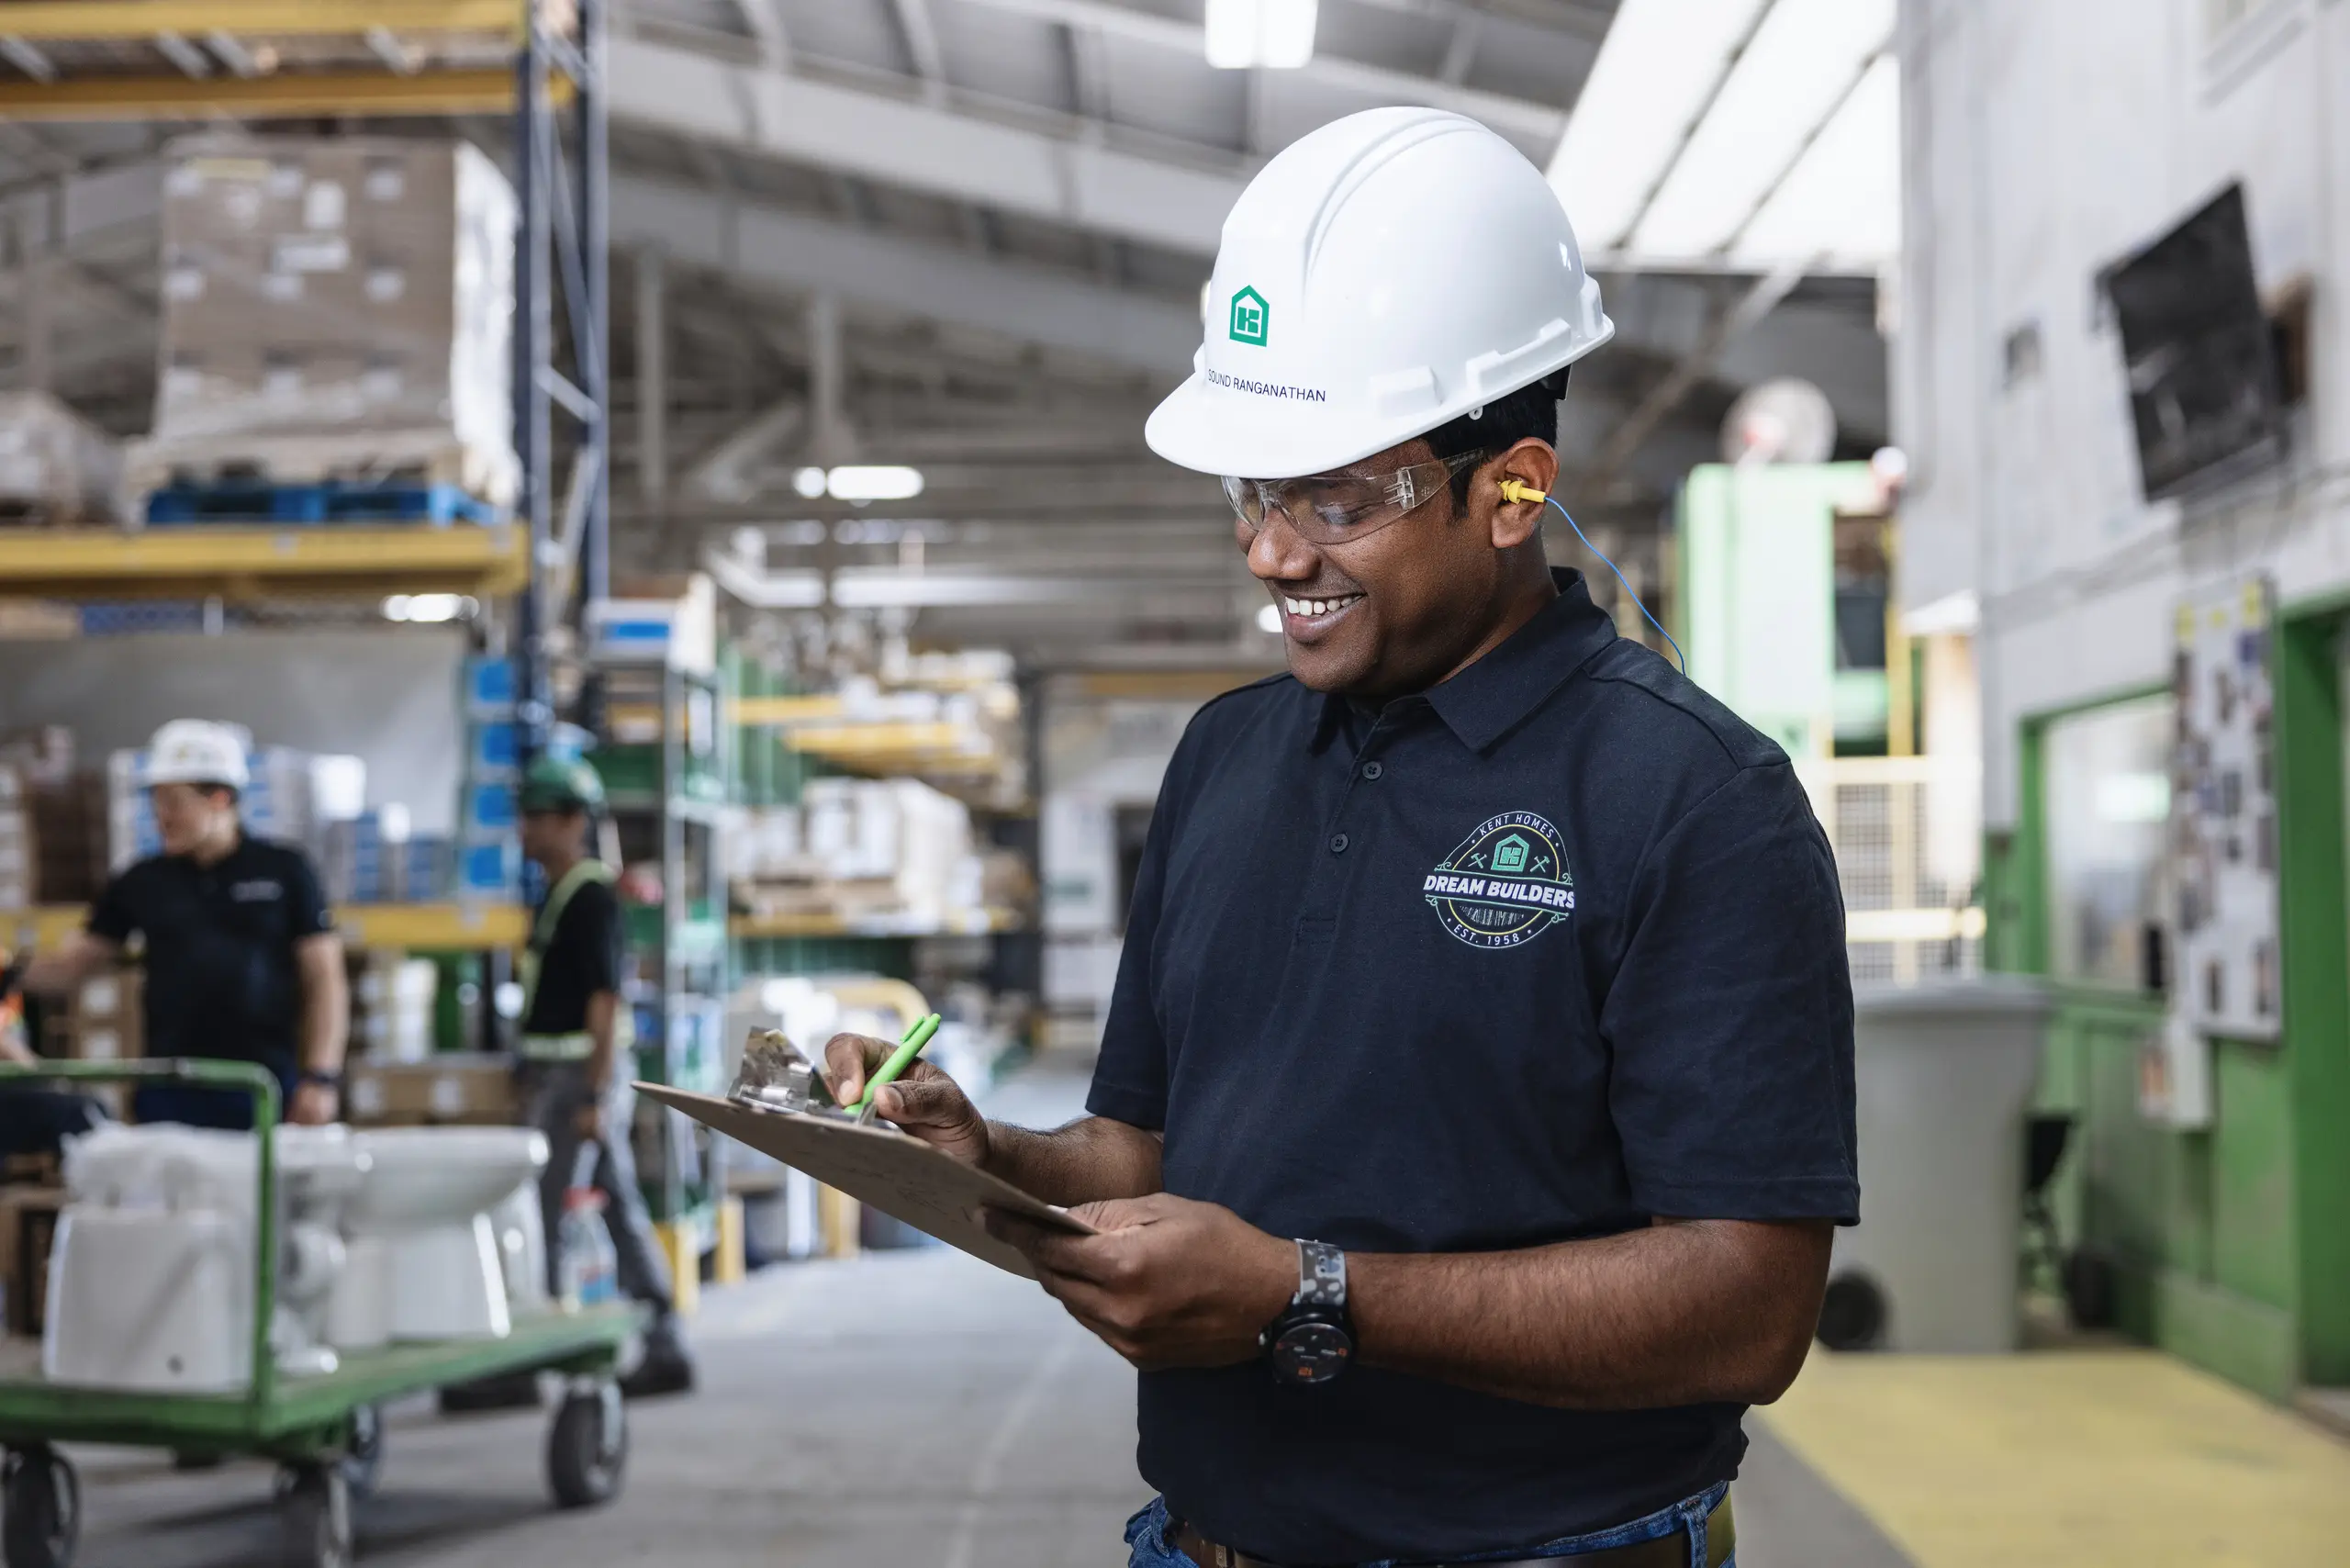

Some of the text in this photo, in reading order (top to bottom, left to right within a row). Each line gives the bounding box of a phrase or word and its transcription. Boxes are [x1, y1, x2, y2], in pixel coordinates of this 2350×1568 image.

[1208, 368, 1326, 402] SOUND RANGANATHAN
[1479, 813, 1555, 839] KENT HOMES
[1423, 875, 1575, 910] DREAM BUILDERS
[1453, 924, 1520, 946] EST. 1958
